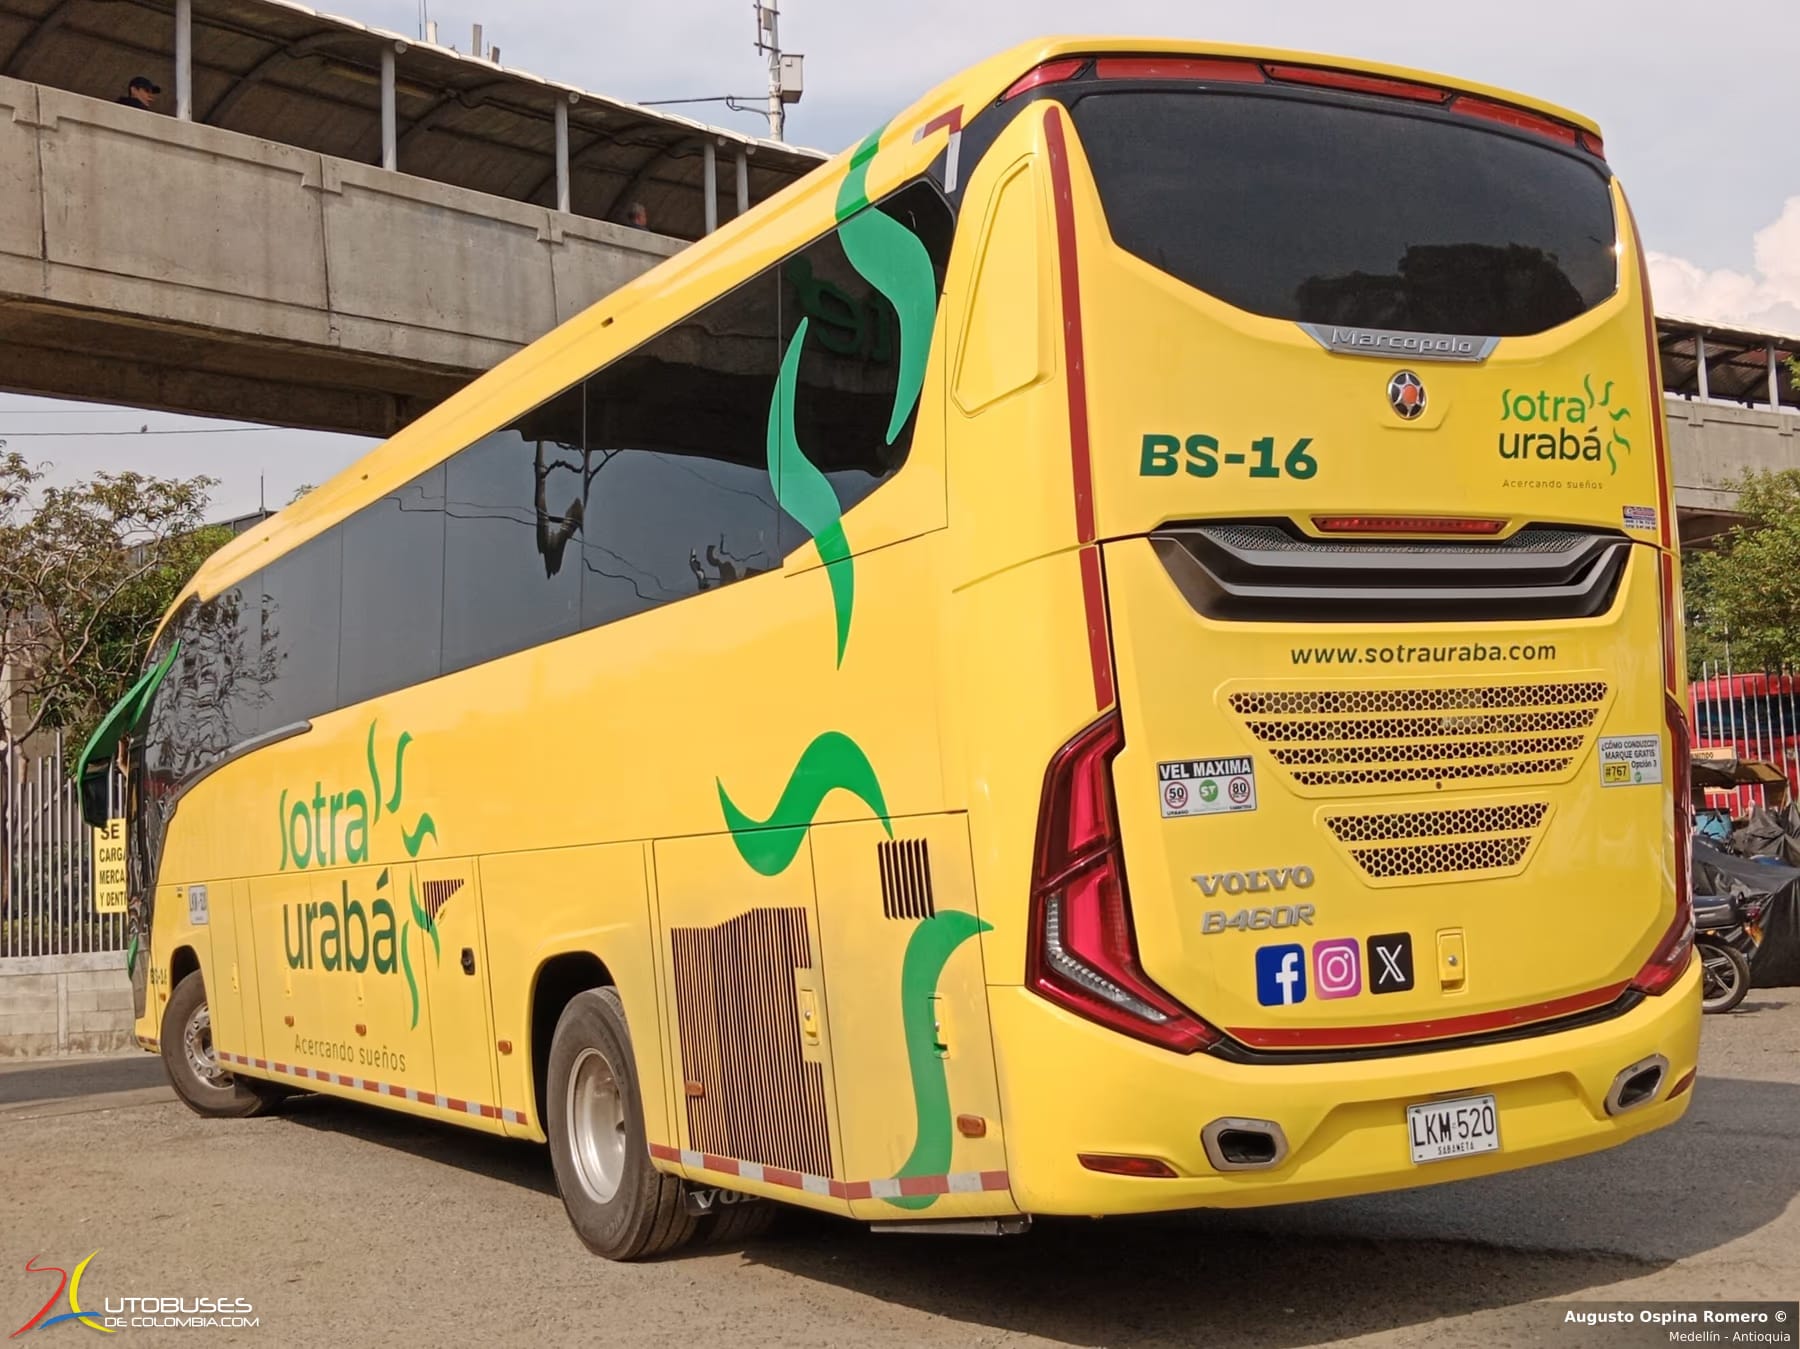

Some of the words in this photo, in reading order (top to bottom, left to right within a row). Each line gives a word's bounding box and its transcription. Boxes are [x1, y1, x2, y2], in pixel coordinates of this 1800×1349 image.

[1331, 327, 1472, 354] Marcopolo
[1499, 426, 1601, 461] urabá
[1139, 434, 1318, 480] BS-16
[1502, 480, 1562, 489] Acercando
[1567, 480, 1603, 489] sueños
[1291, 643, 1556, 665] www.sotrauraba.com
[1605, 750, 1632, 760] MARQUE
[1634, 749, 1656, 758] GRATIS
[1631, 760, 1652, 769] Opción
[1160, 764, 1189, 780] VEL
[1193, 759, 1251, 777] MAXIMA
[1605, 765, 1627, 776] #767
[1169, 788, 1185, 799] 50
[1232, 782, 1247, 794] 80
[100, 823, 120, 840] SE
[1192, 866, 1315, 897] VOLVO
[100, 892, 104, 906] Y
[283, 867, 398, 975] urabá
[1201, 903, 1316, 935] B460R
[294, 1033, 354, 1064] Acercando
[359, 1045, 406, 1072] sueños
[1412, 1111, 1452, 1147] LKM
[1456, 1105, 1495, 1139] 520
[1438, 1141, 1474, 1155] SABANETA
